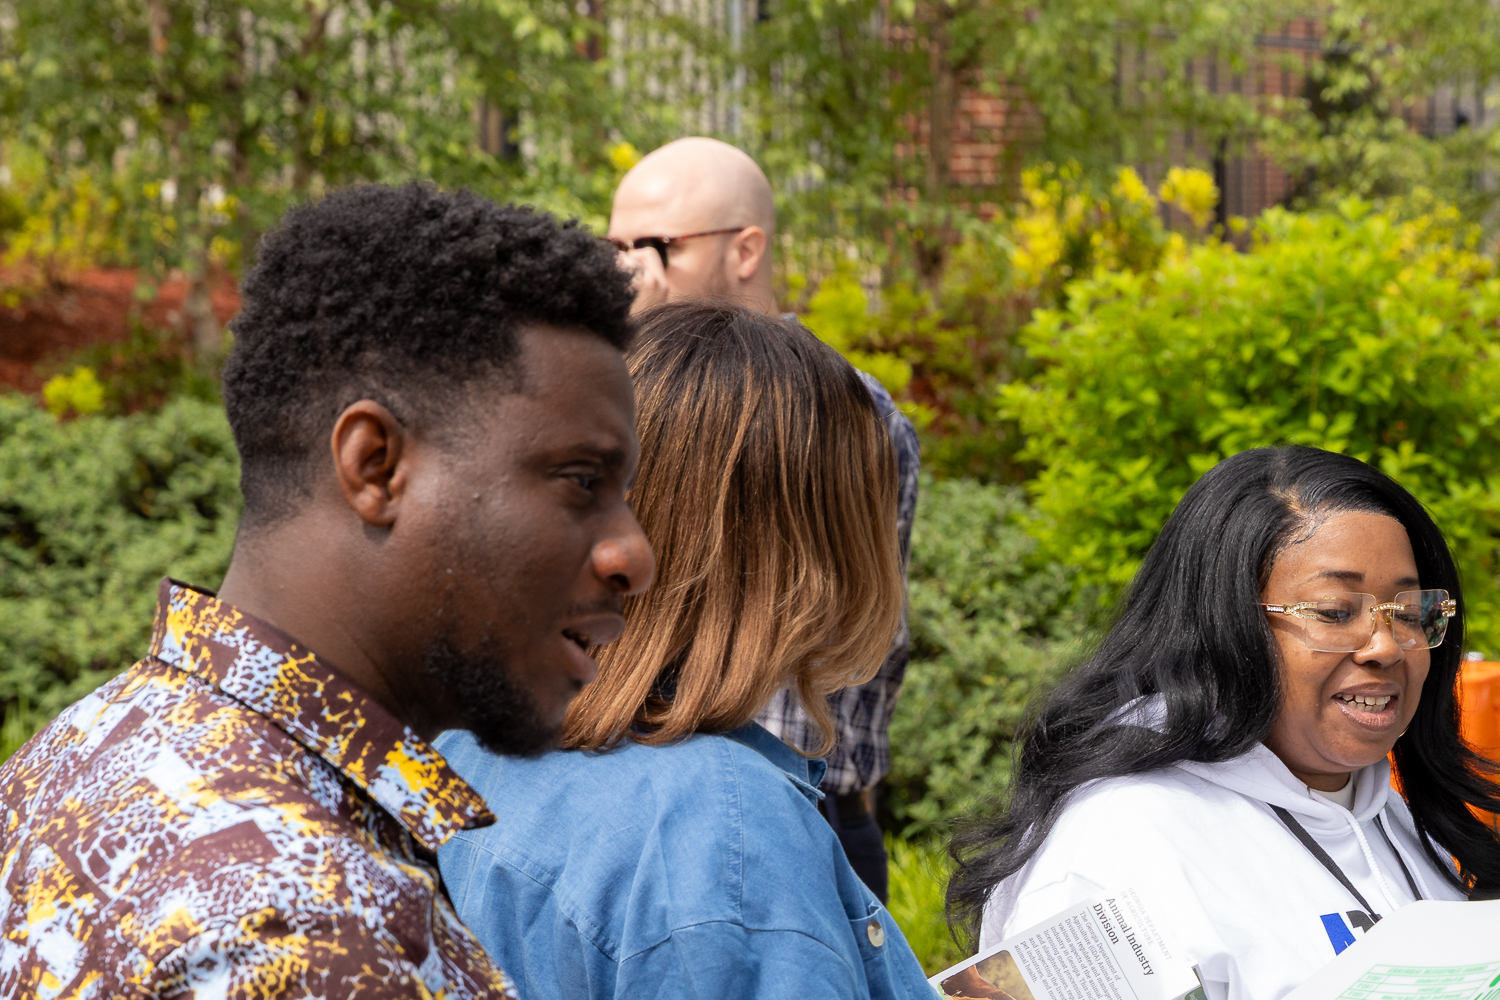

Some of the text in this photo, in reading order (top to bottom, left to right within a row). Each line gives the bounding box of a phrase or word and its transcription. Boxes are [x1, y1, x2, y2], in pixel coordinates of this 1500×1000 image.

[1078, 910, 1089, 922] The
[1083, 921, 1100, 943] Georgia
[1092, 902, 1122, 944] Division
[1105, 895, 1156, 978] Animal Industry
[1120, 890, 1154, 946] OF AGRICULTURE
[1127, 886, 1172, 961] GEORGIA DEPARTMENT
[1013, 943, 1029, 964] animal
[1020, 940, 1029, 950] pet
[1025, 949, 1046, 979] industries,
[1041, 978, 1051, 990] and
[1028, 936, 1038, 948] and
[1033, 947, 1054, 978] inspecting
[1050, 976, 1060, 987] the
[1035, 932, 1045, 945] and
[1040, 943, 1070, 990] slaughterhouses,
[1041, 929, 1061, 955] licensing
[1056, 954, 1068, 969] meat
[1063, 968, 1084, 999] processing
[1049, 925, 1066, 950] industry
[1078, 977, 1089, 991] This
[1057, 922, 1072, 943] various
[1067, 942, 1083, 964] aspects
[1083, 968, 1092, 979] the
[1088, 978, 1103, 999] animal
[1064, 918, 1081, 941] Division
[1075, 940, 1094, 966] regulates
[1090, 965, 1100, 977] and
[1070, 914, 1092, 946] Agriculture
[1087, 944, 1101, 962] (GDA)
[1097, 960, 1112, 982] Animal
[1095, 942, 1117, 975] Department
